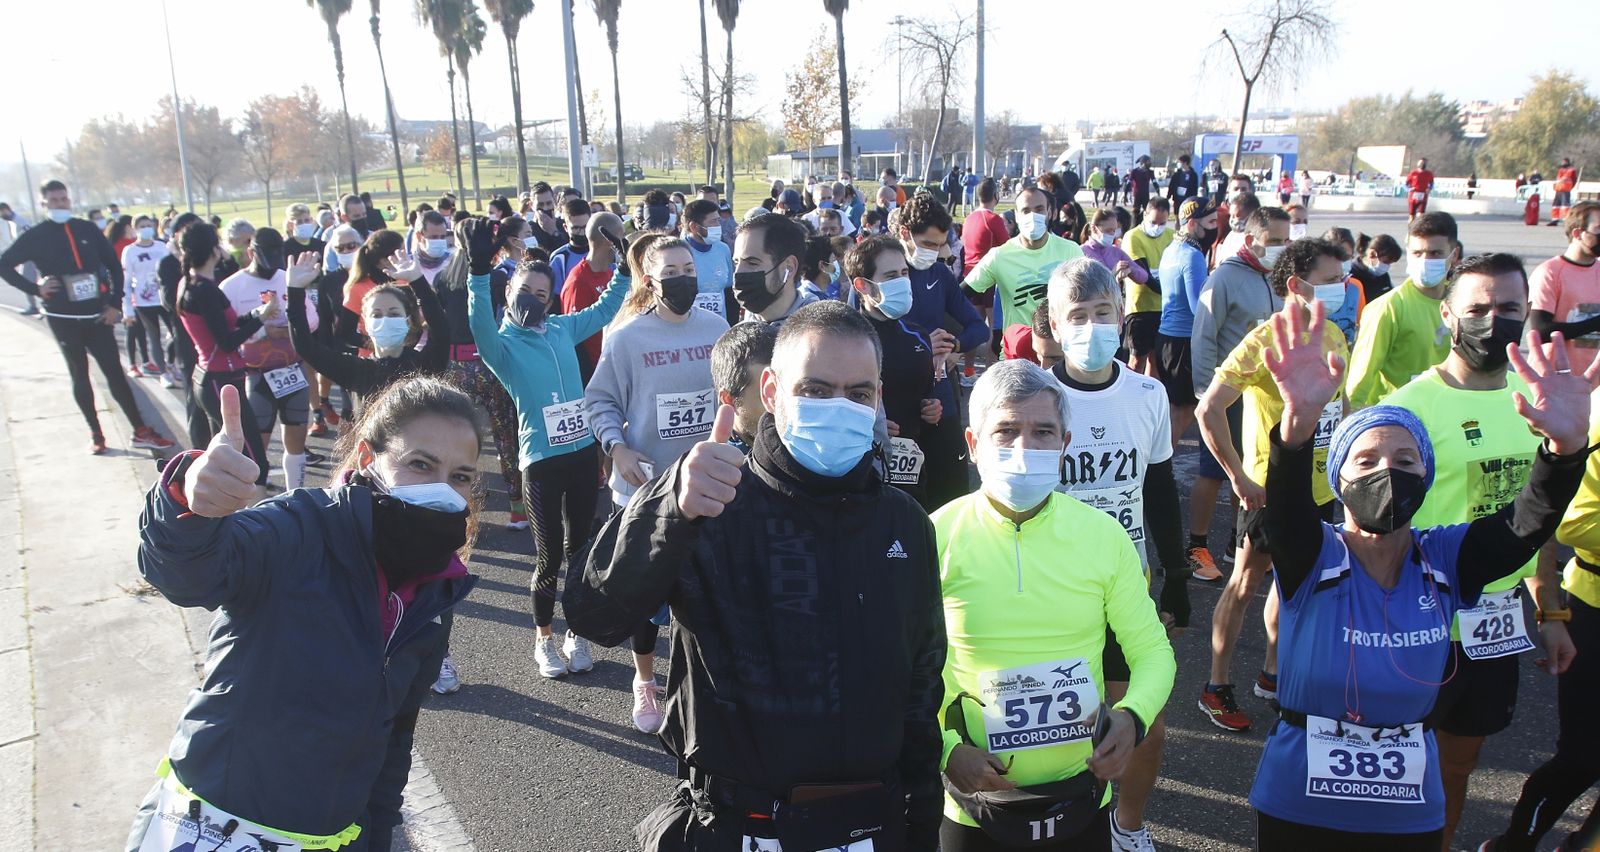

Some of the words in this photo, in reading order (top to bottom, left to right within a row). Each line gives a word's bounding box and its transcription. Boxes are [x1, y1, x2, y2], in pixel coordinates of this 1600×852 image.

[643, 350, 680, 367] NEW
[684, 344, 714, 361] YOR
[275, 373, 298, 390] 349
[556, 414, 584, 433] 455
[668, 407, 706, 427] 547
[670, 423, 713, 435] CORDOBARIA
[889, 455, 917, 472] 509
[1343, 624, 1448, 648] TROTASIERRA
[1473, 613, 1515, 641] 428
[1468, 648, 1479, 656] LA
[1479, 638, 1528, 655] CORDOBARIA
[1005, 690, 1082, 729] 573
[992, 736, 1009, 748] LA
[1011, 725, 1094, 745] CORDOBARI
[1329, 749, 1406, 780] 383
[1312, 780, 1330, 793] LA
[1332, 782, 1418, 798] CORDOBARIA
